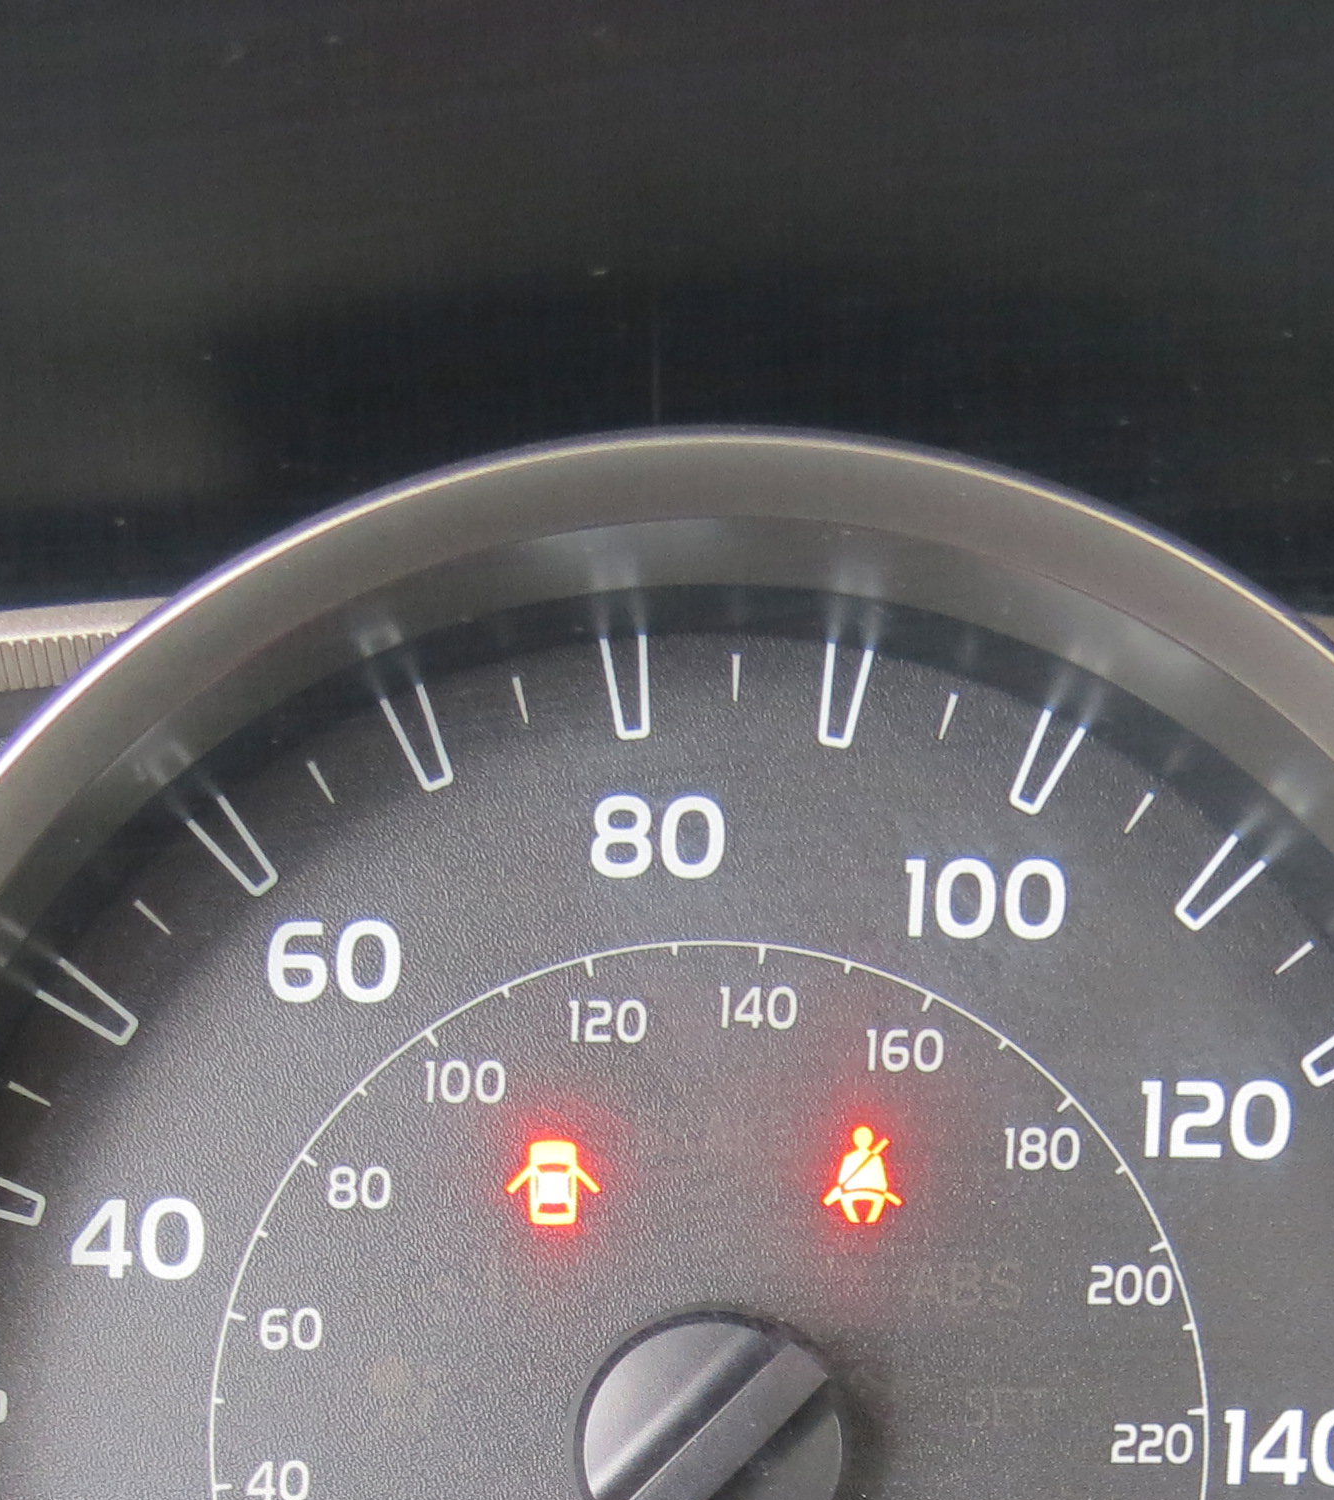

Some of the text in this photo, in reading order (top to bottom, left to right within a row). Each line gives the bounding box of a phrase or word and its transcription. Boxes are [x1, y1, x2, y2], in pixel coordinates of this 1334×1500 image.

[590, 794, 726, 880] 80
[905, 857, 1067, 940] 100
[266, 919, 402, 1004] 60
[568, 999, 648, 1044] 120
[719, 985, 798, 1030] 140
[866, 1028, 944, 1073] 160
[425, 1059, 506, 1105] 100
[1141, 1079, 1291, 1160] 120
[1004, 1126, 1081, 1171] 180
[327, 1165, 392, 1210] 80
[70, 1196, 205, 1281] 40
[1087, 1264, 1172, 1306] 200
[258, 1305, 323, 1351] 60
[1110, 1422, 1194, 1465] 220
